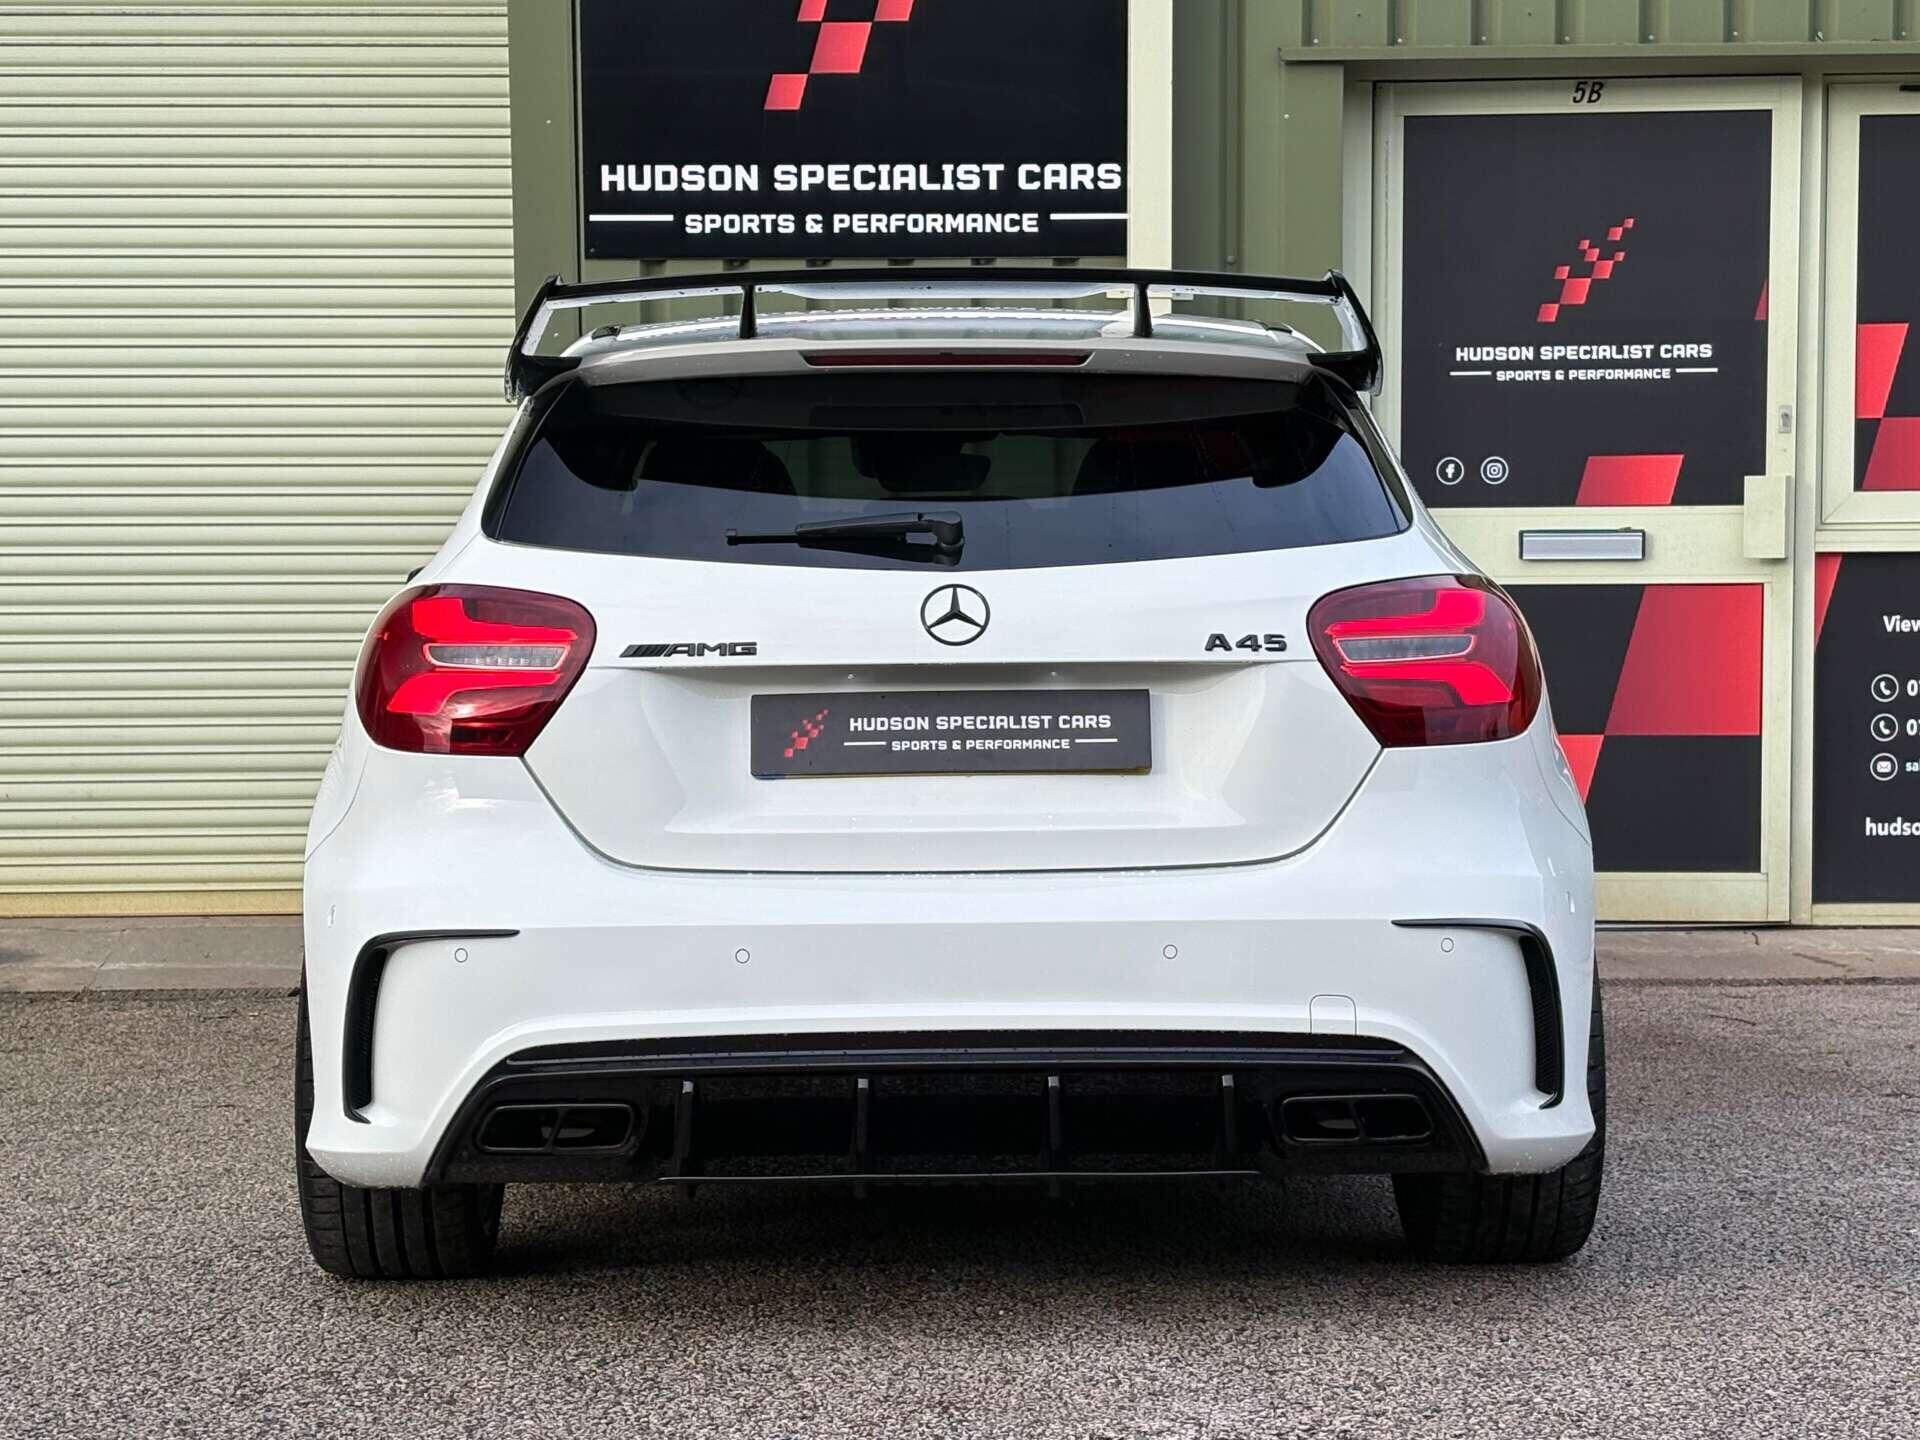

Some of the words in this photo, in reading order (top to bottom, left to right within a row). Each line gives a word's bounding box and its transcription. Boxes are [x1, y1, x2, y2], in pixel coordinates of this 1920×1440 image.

[1573, 80, 1604, 104] 5B
[601, 164, 758, 191] HUDSON
[774, 164, 1004, 191] SPECIALIST
[1018, 164, 1121, 190] CARS
[685, 214, 795, 233] SPORTS
[806, 214, 823, 233] &
[834, 213, 1038, 233] PERFORMANCE
[1456, 346, 1533, 361] HUDSON
[1540, 345, 1654, 360] SPECIALIST
[1660, 344, 1713, 359] CARS
[1496, 370, 1551, 381] SPORTS
[1555, 370, 1565, 381] &
[1569, 368, 1671, 380] PERFORMANCE
[663, 642, 757, 657] AMG
[1205, 633, 1287, 652] A45
[849, 716, 929, 732] HUDSON
[936, 715, 1052, 730] SPECIALIST
[1058, 715, 1111, 729] CARS
[892, 740, 947, 751] SPORTS
[952, 740, 961, 751] &
[966, 739, 1070, 751] PERFORMANCE
